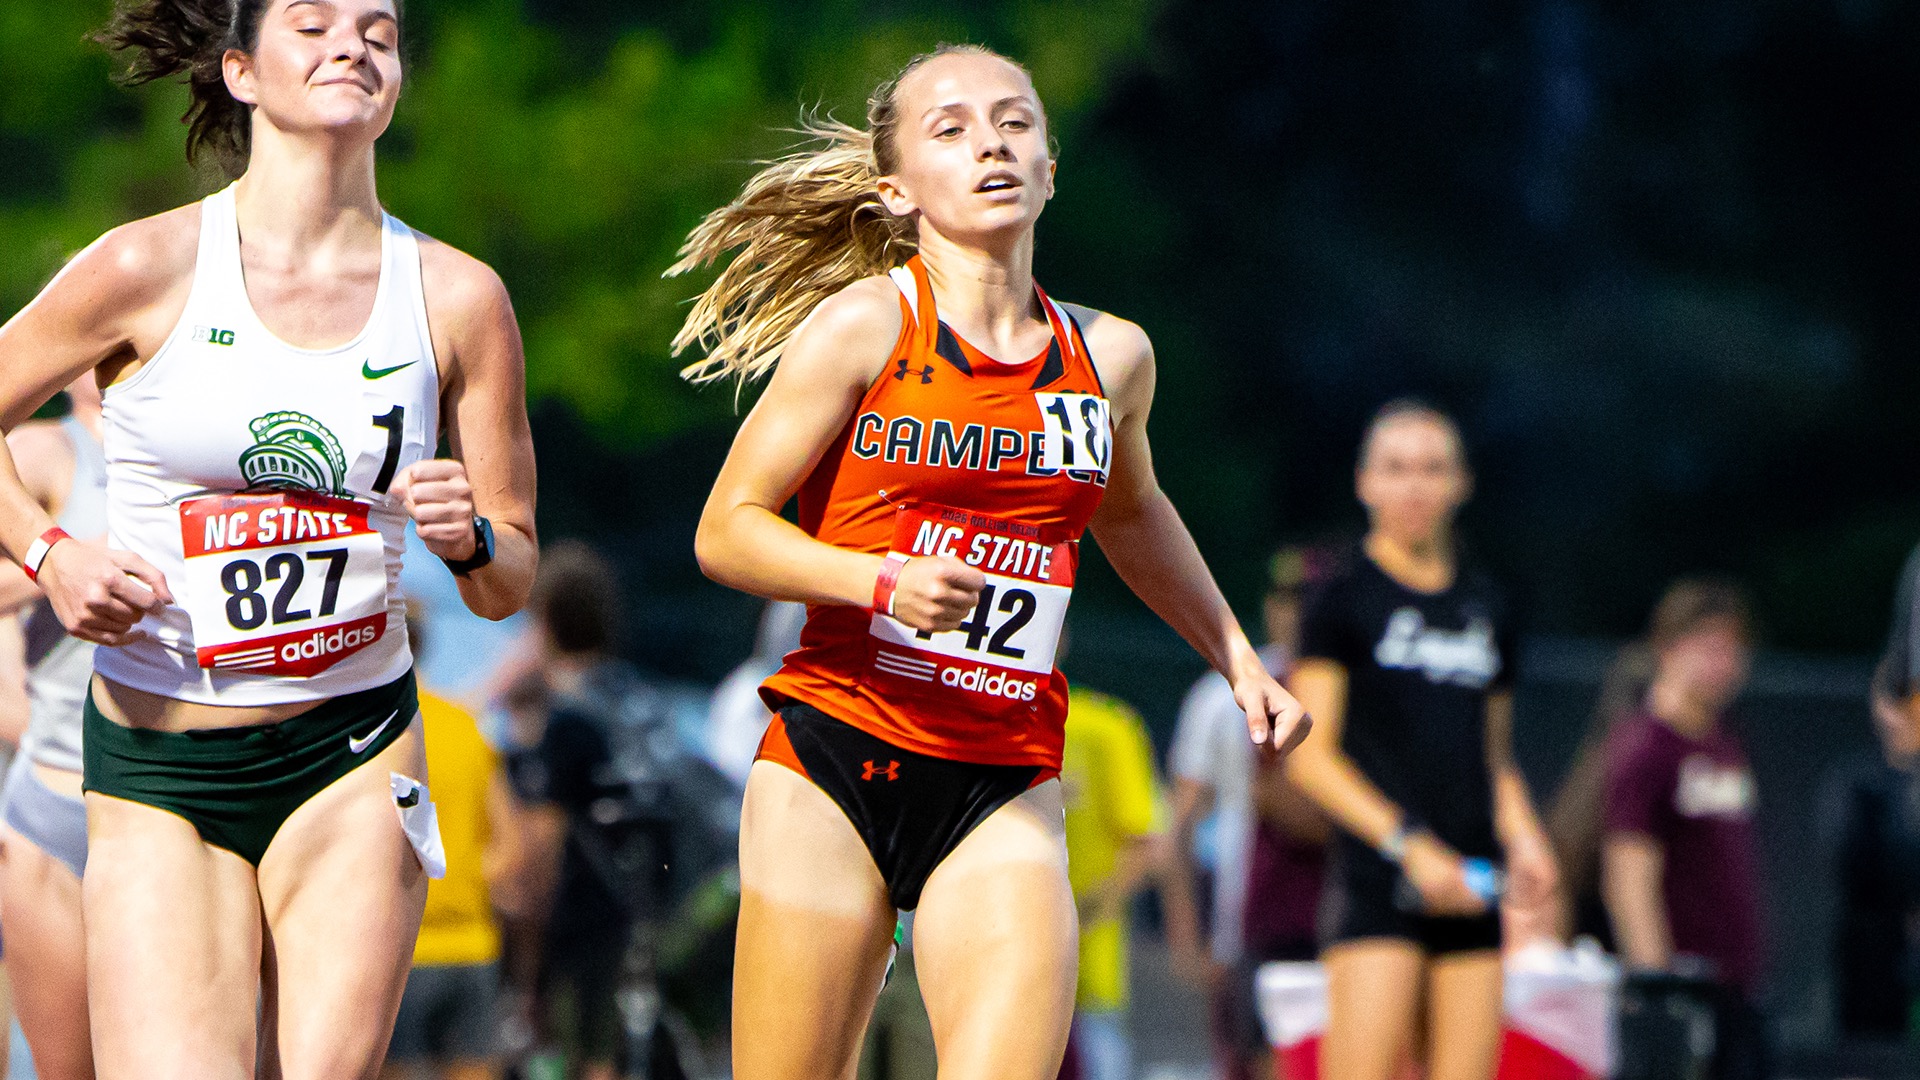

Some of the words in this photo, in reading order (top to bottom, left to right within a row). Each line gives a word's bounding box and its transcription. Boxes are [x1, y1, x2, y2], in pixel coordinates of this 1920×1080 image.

[372, 404, 405, 495] 1
[1046, 396, 1109, 470] 18
[203, 511, 250, 551] NC
[257, 506, 353, 543] STATE
[911, 519, 964, 558] NC
[965, 532, 1054, 580] STATE
[220, 548, 349, 632] 827
[915, 583, 1037, 660] 42
[280, 625, 376, 663] adidas
[940, 667, 1037, 702] adidas
